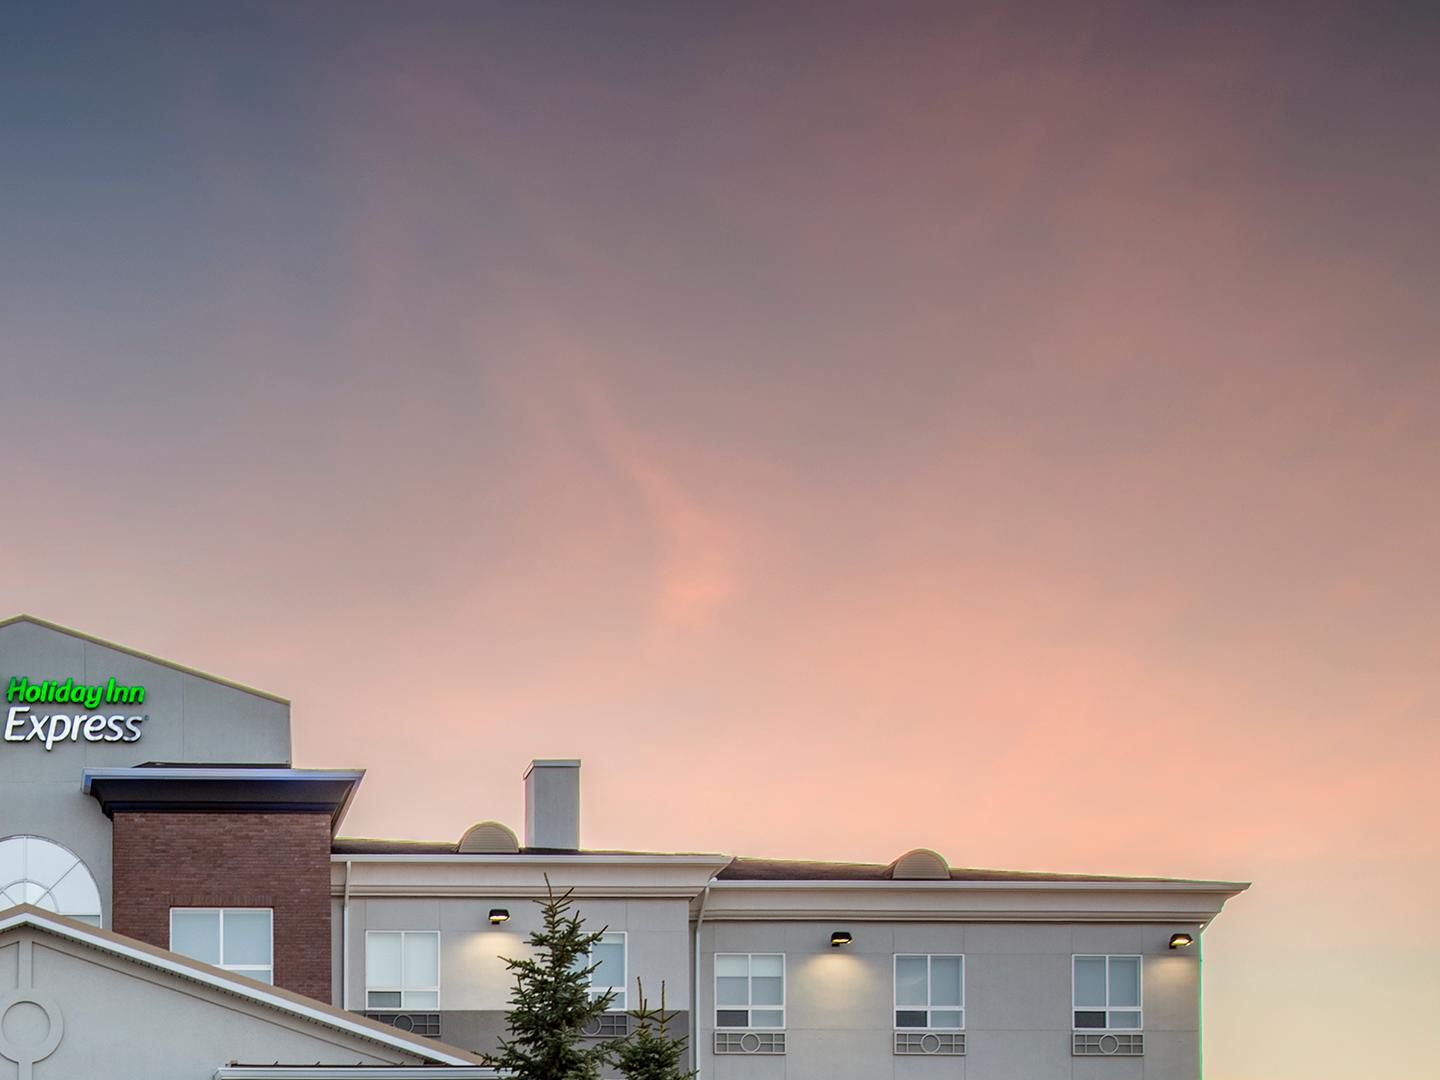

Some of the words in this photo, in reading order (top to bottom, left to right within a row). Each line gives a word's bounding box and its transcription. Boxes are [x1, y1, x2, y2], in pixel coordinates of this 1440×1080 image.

[6, 676, 104, 709] Holiday
[105, 677, 145, 703] Inn
[4, 705, 143, 751] Express
